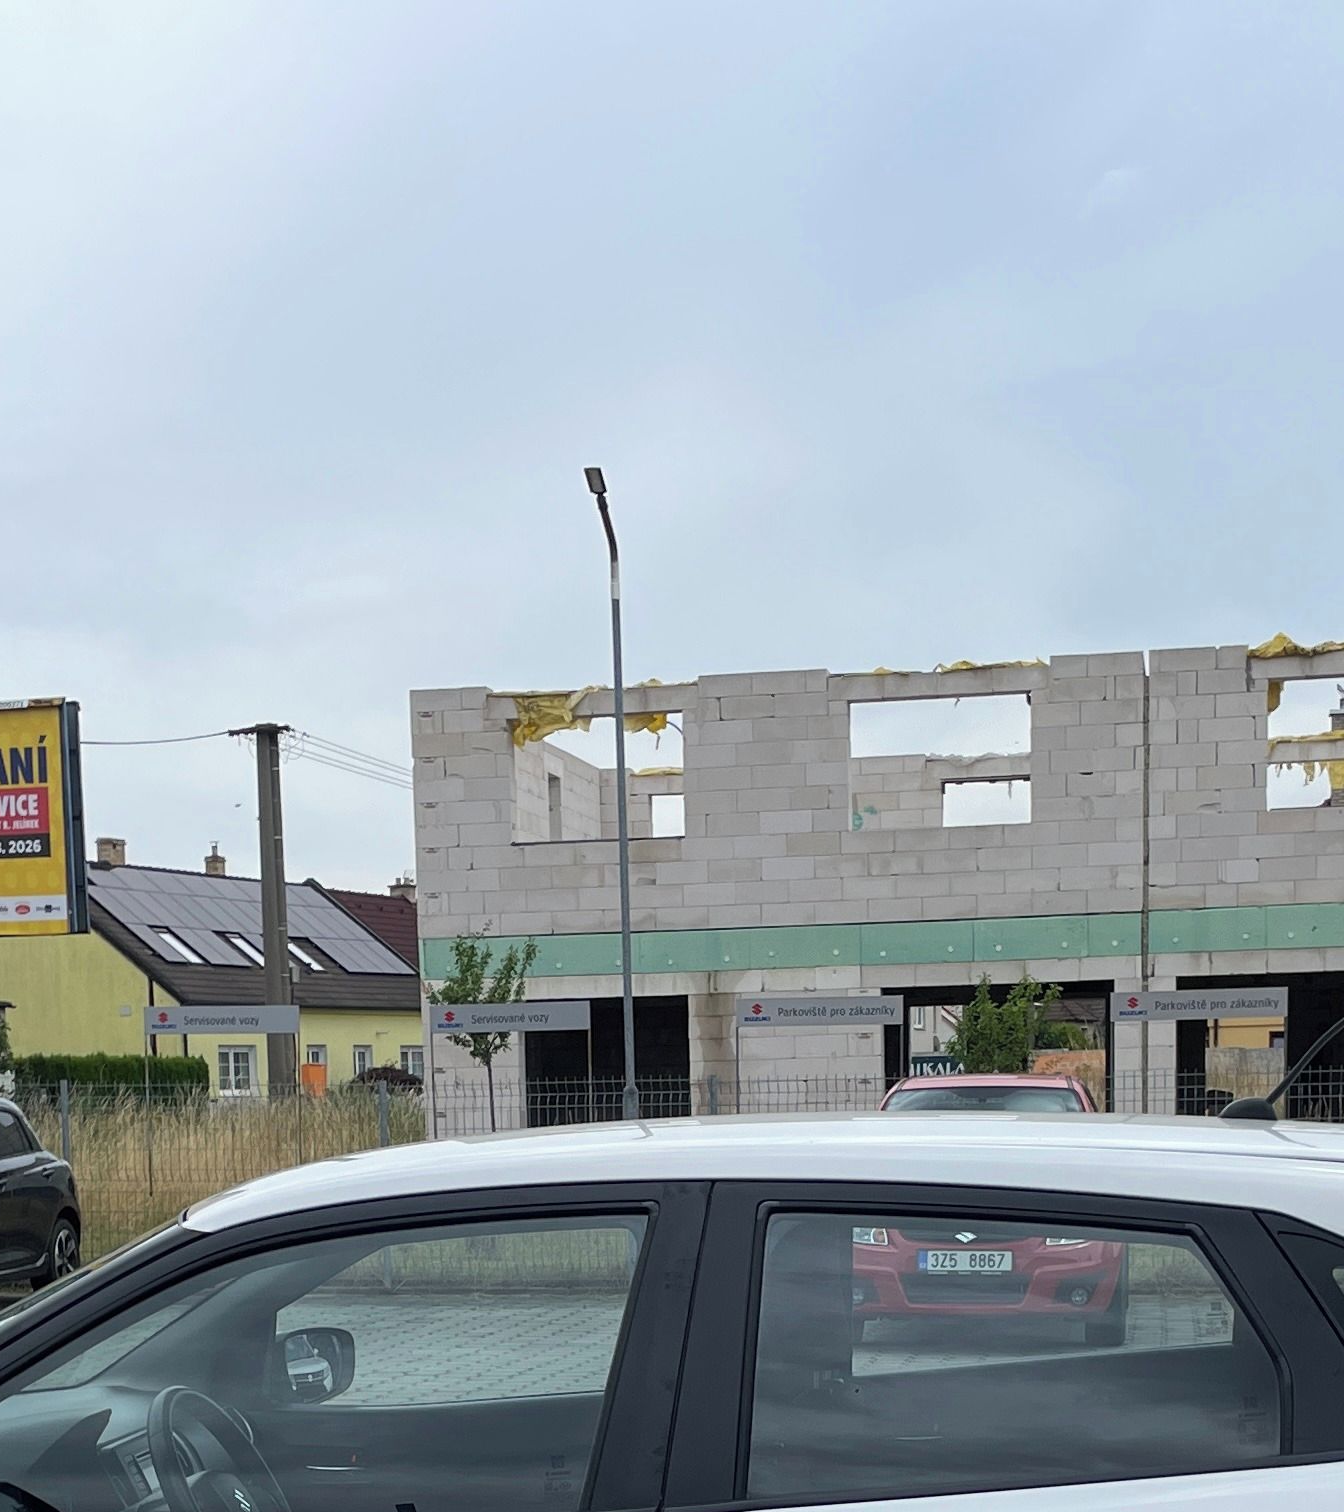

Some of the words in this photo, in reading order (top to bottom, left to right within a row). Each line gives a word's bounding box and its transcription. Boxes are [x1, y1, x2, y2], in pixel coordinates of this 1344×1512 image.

[8, 839, 42, 853] 2026
[1154, 999, 1206, 1010] Parkoviště
[1210, 1000, 1227, 1011] pro
[1229, 998, 1280, 1009] zákazníky
[777, 1006, 827, 1017] Parkoviště
[830, 1008, 846, 1018] pro
[848, 1005, 896, 1017] zákazníky
[183, 1015, 237, 1026] Servisované
[239, 1016, 260, 1027] vozy
[471, 1013, 526, 1025] Servisované
[528, 1013, 551, 1025] vozy
[931, 1253, 958, 1269] 3Z5
[969, 1253, 1005, 1269] 8867
